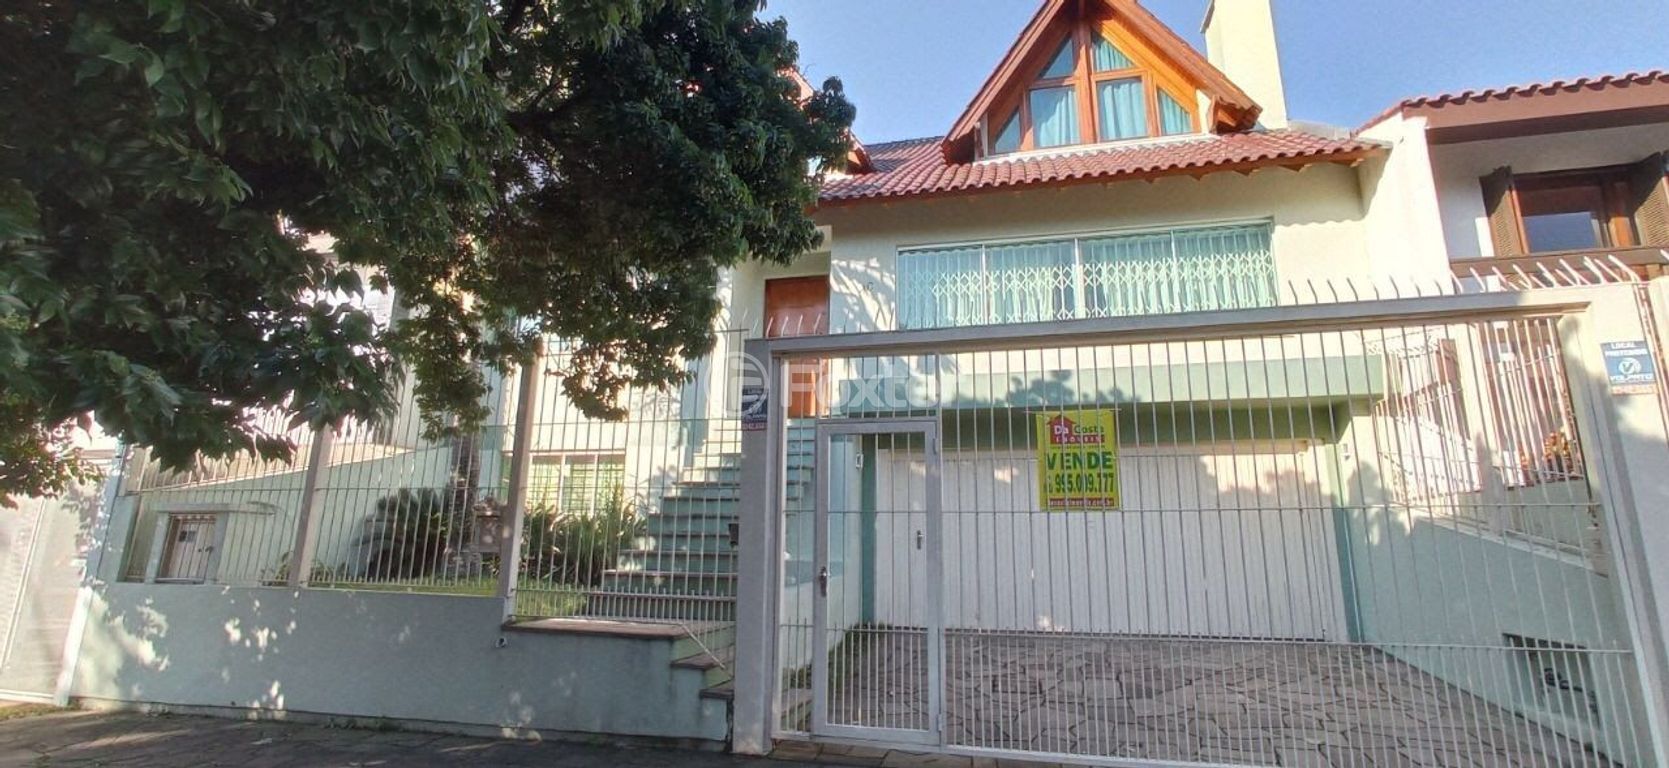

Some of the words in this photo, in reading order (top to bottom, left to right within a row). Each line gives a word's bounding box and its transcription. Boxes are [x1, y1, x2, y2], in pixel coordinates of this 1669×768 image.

[1054, 425, 1069, 434] Da
[1074, 425, 1104, 433] Costa
[1047, 452, 1114, 470] VENDE
